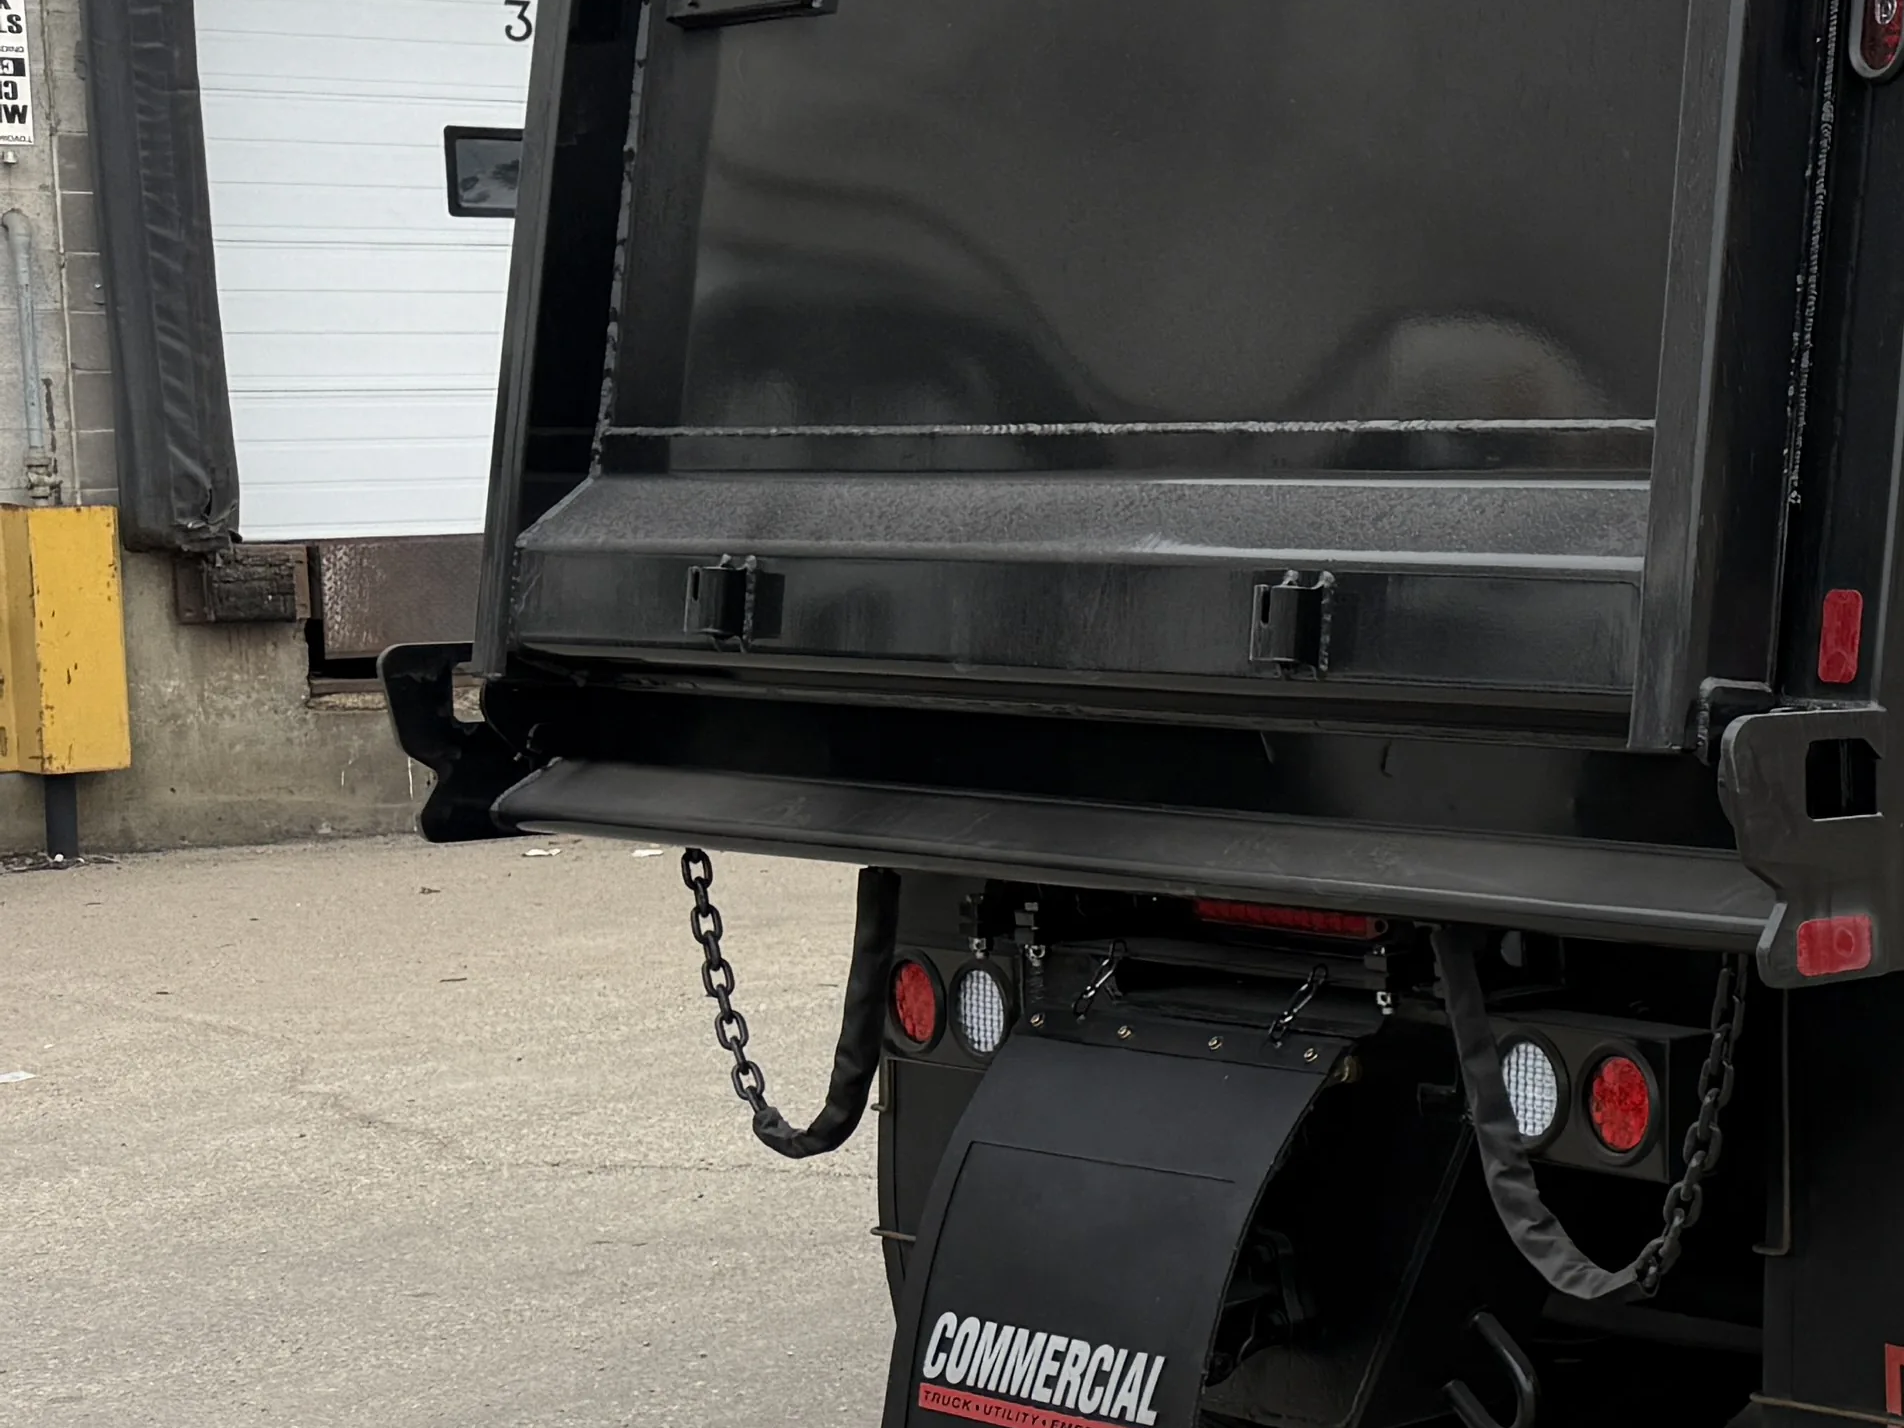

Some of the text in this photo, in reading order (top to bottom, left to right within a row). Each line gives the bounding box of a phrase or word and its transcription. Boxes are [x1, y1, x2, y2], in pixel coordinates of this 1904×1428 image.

[503, 0, 534, 42] 3
[922, 1311, 1167, 1427] COMMERCIAL
[923, 1389, 971, 1412] TRUCK
[983, 1403, 1041, 1427] UTILITY
